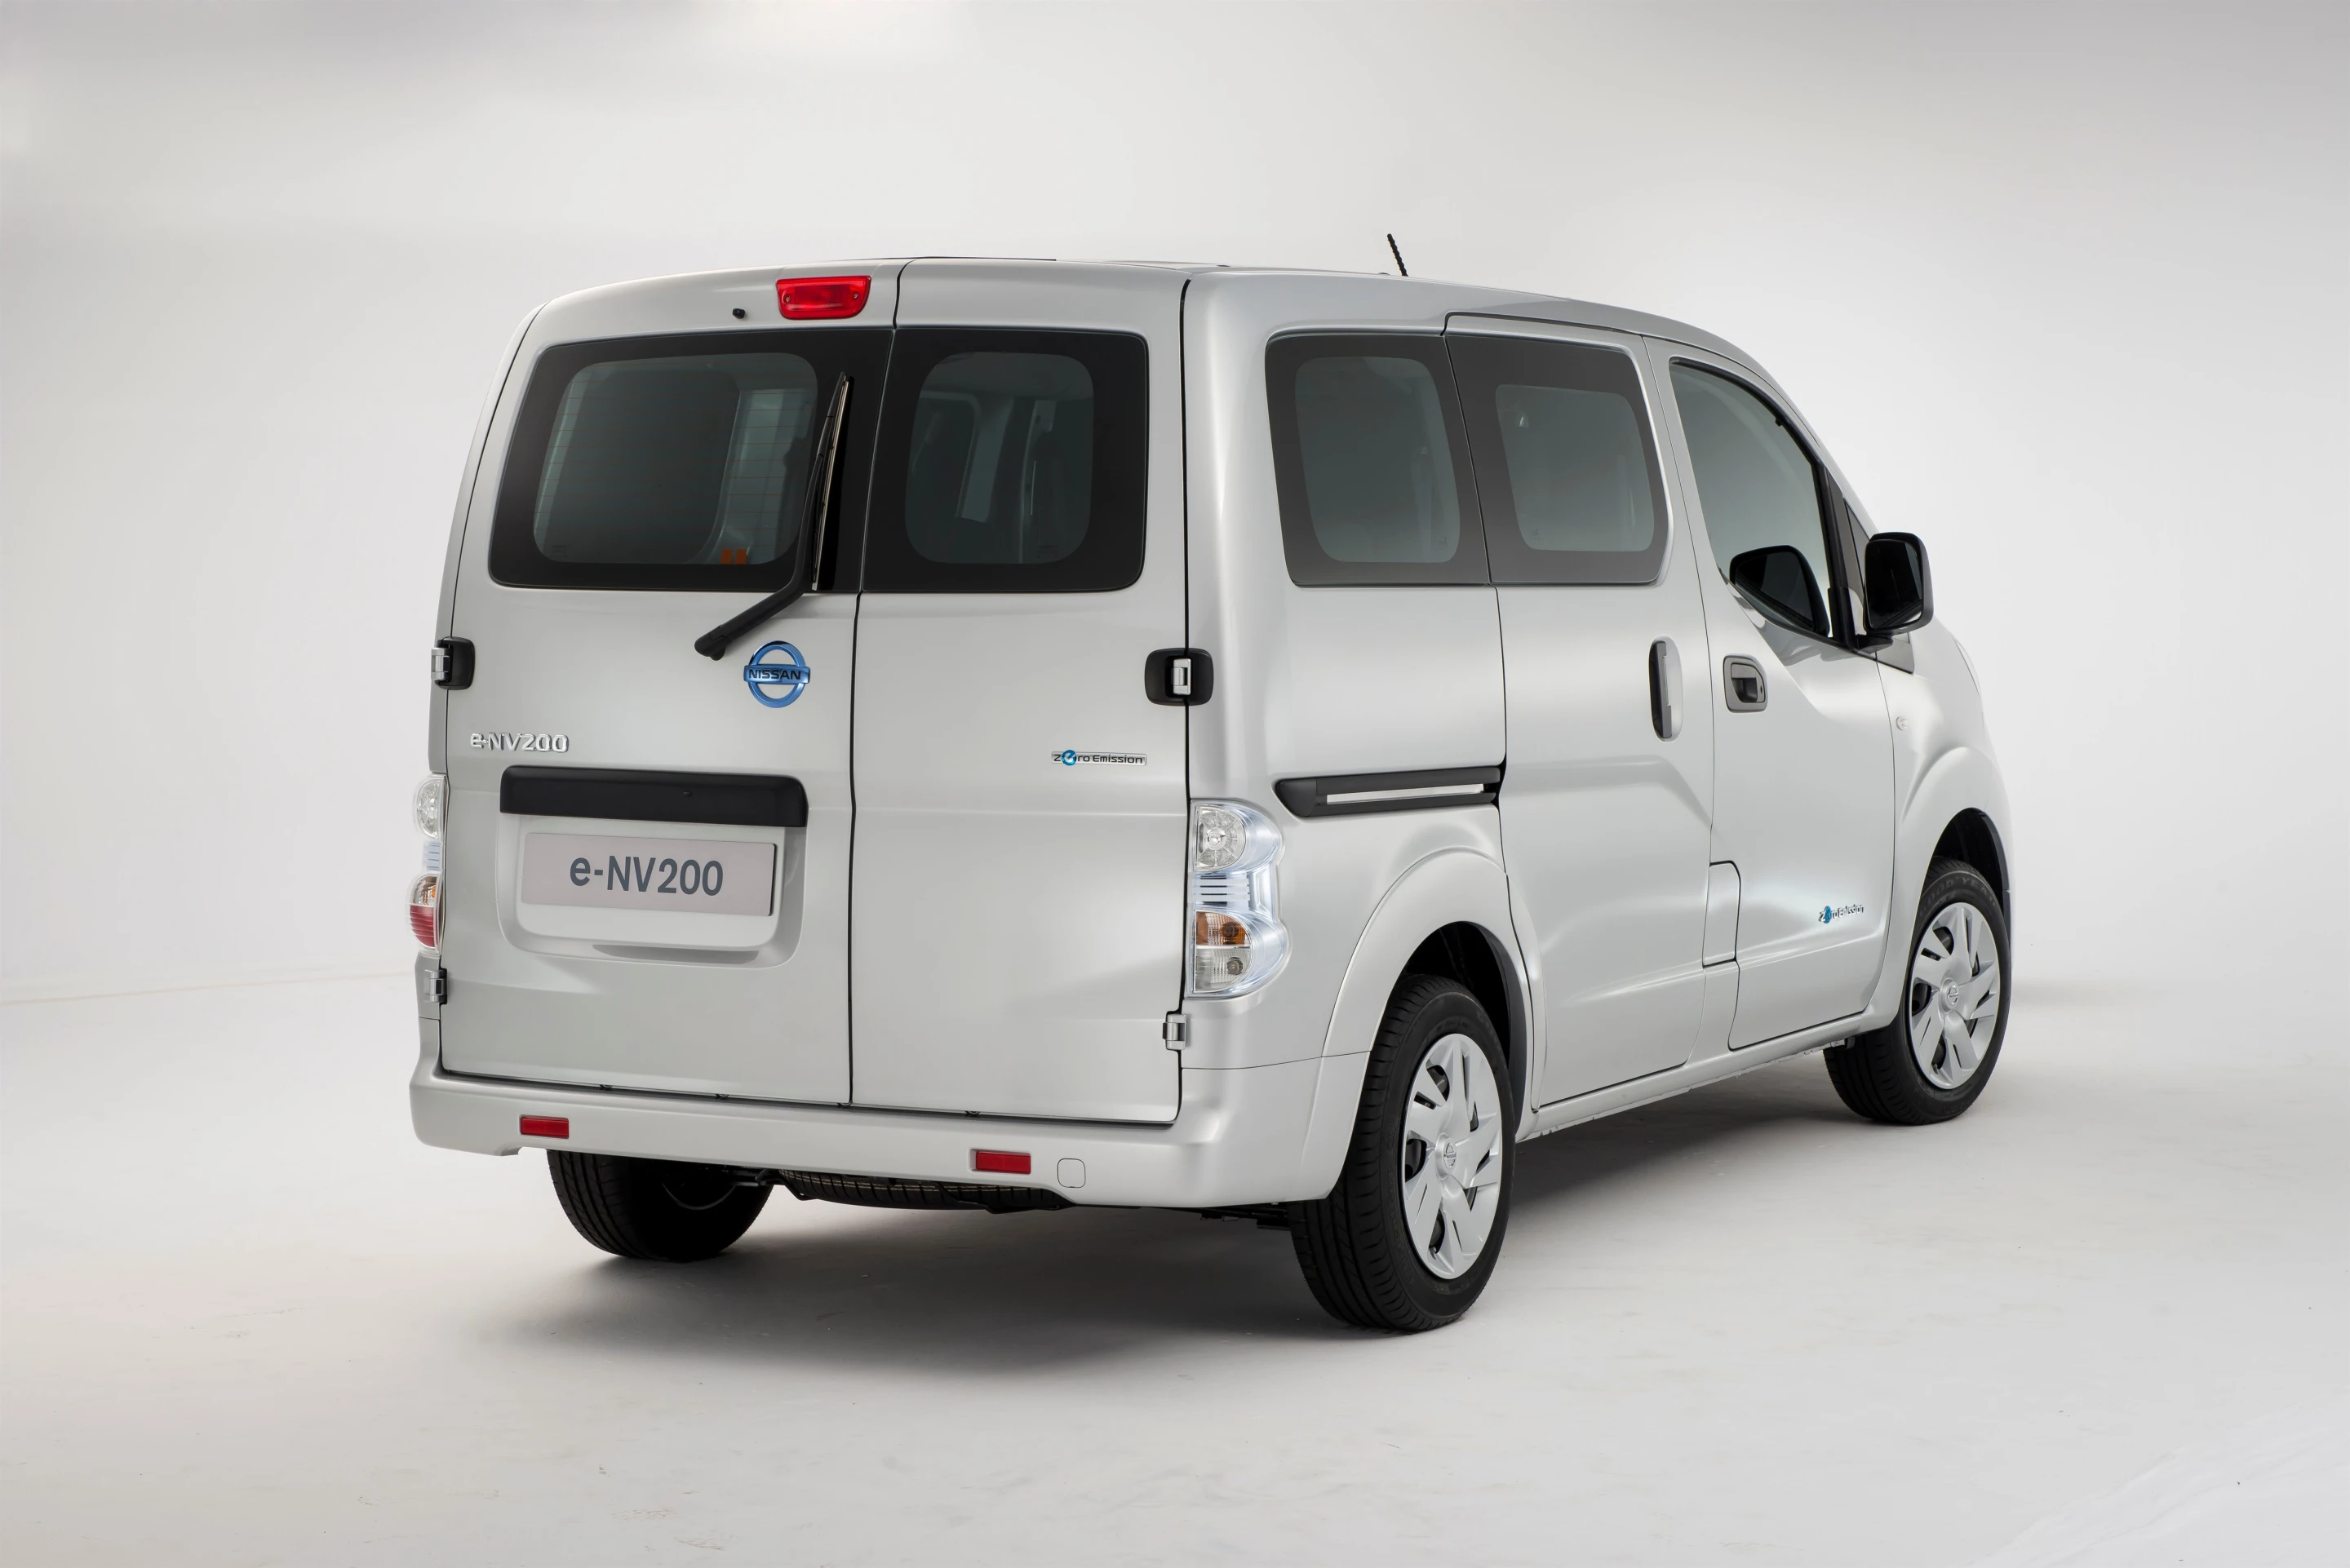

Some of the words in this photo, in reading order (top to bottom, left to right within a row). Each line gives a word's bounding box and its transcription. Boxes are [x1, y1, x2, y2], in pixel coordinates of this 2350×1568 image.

[748, 668, 801, 680] NISSAN
[470, 732, 570, 753] e-NV200
[1093, 754, 1143, 764] Emission
[570, 855, 724, 897] e-NV200
